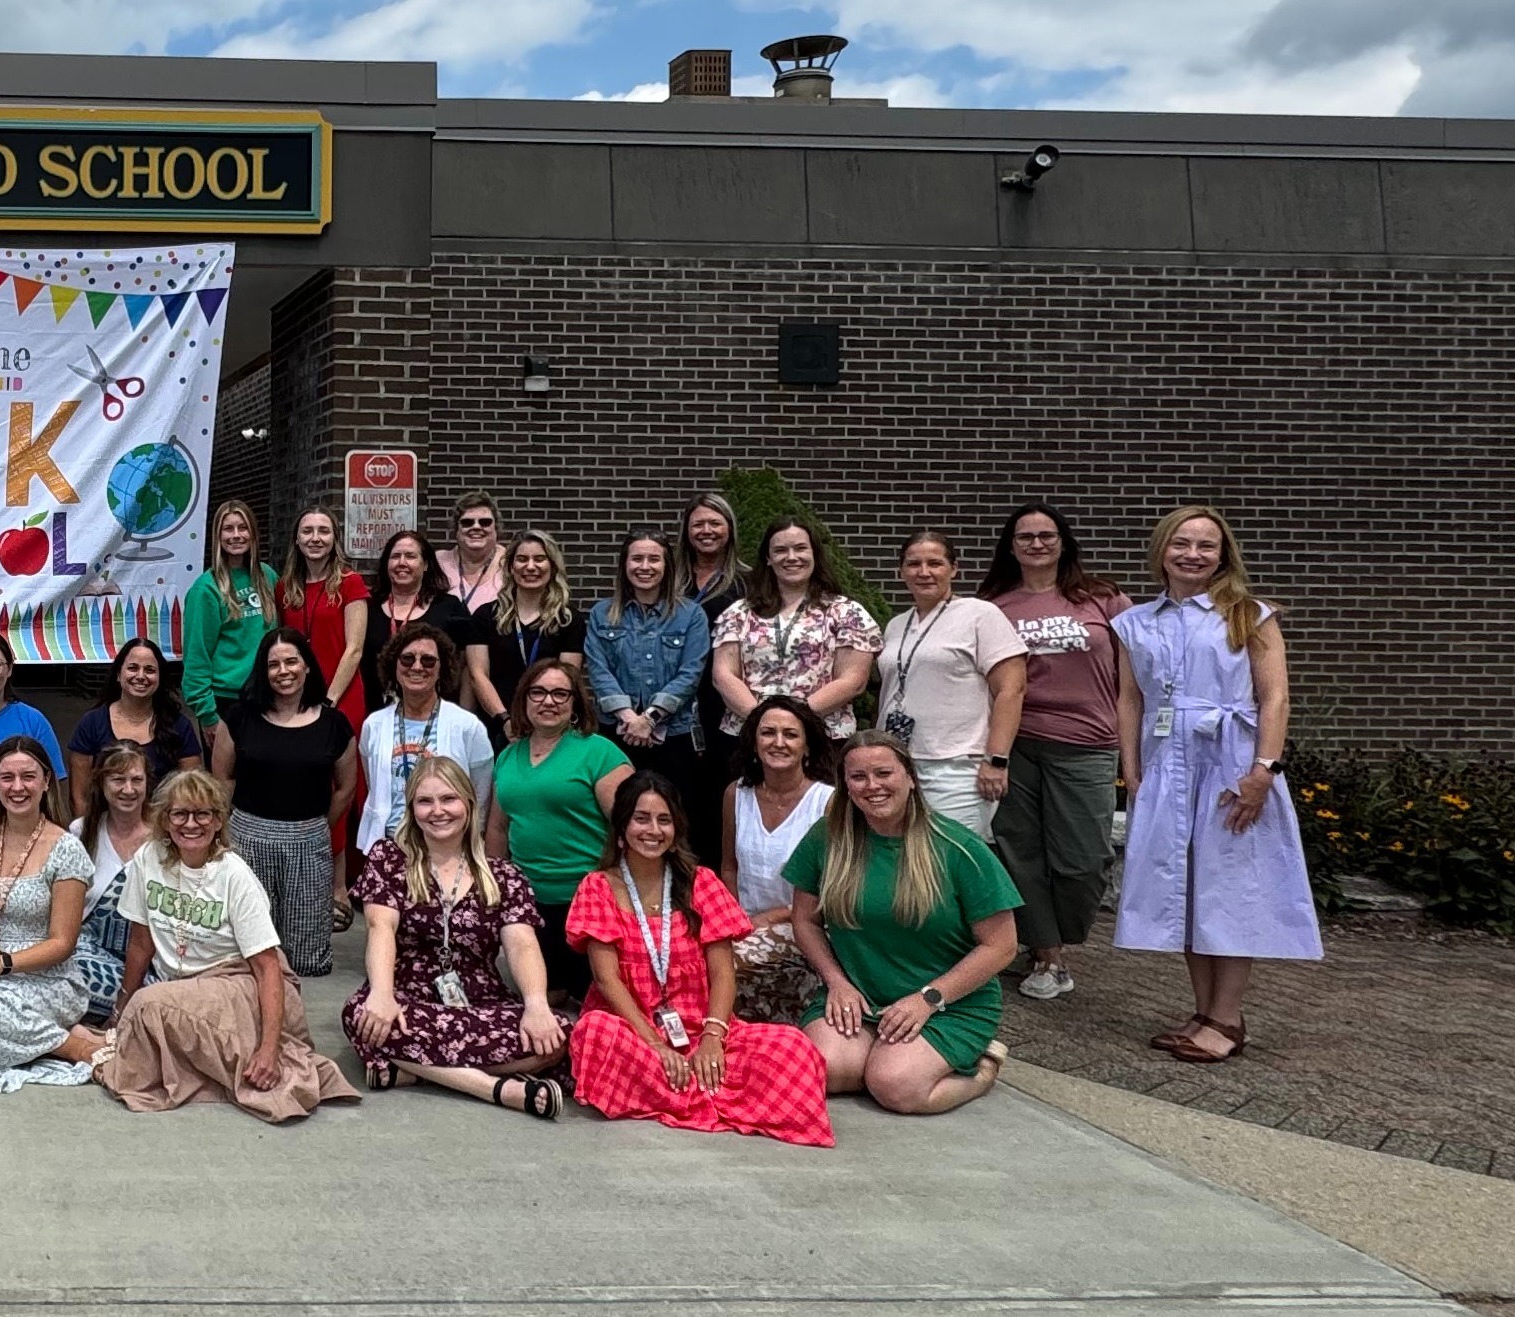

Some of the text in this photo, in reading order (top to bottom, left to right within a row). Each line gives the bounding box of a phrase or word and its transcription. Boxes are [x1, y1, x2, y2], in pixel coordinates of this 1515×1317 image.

[38, 144, 288, 200] SCHOOL
[367, 464, 395, 478] STOP
[351, 493, 411, 505] ALL VISITORS
[368, 508, 394, 520] MUST
[356, 522, 391, 535] REPORT
[351, 538, 375, 550] MAIN
[1017, 615, 1073, 630] In my
[1016, 622, 1090, 641] ookish
[1048, 636, 1091, 652] era
[146, 879, 224, 931] TEACH
